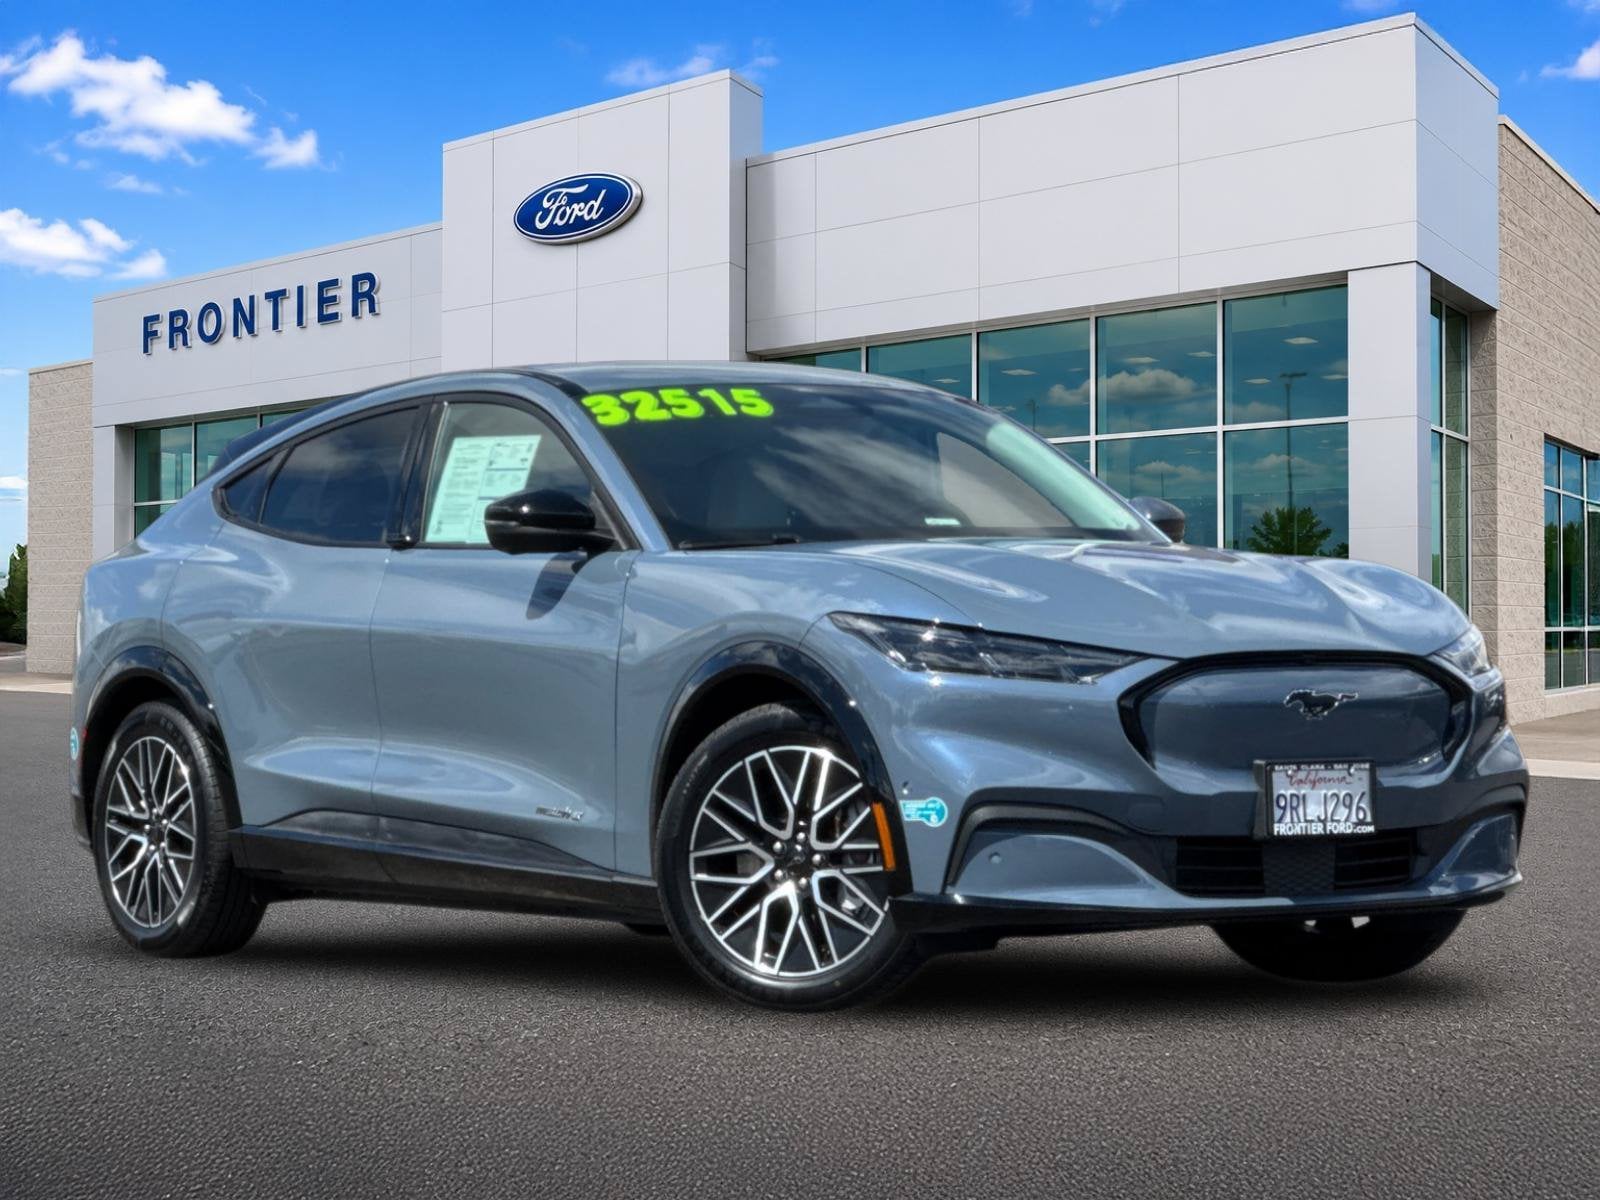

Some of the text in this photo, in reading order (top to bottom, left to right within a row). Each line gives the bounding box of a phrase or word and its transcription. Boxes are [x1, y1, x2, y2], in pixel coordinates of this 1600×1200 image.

[535, 183, 607, 230] Ford
[142, 271, 381, 356] FRONTIER
[581, 388, 774, 426] 32515
[1288, 772, 1352, 790] California
[1275, 792, 1367, 823] 9RLJ296
[1273, 822, 1324, 836] FRONTIER
